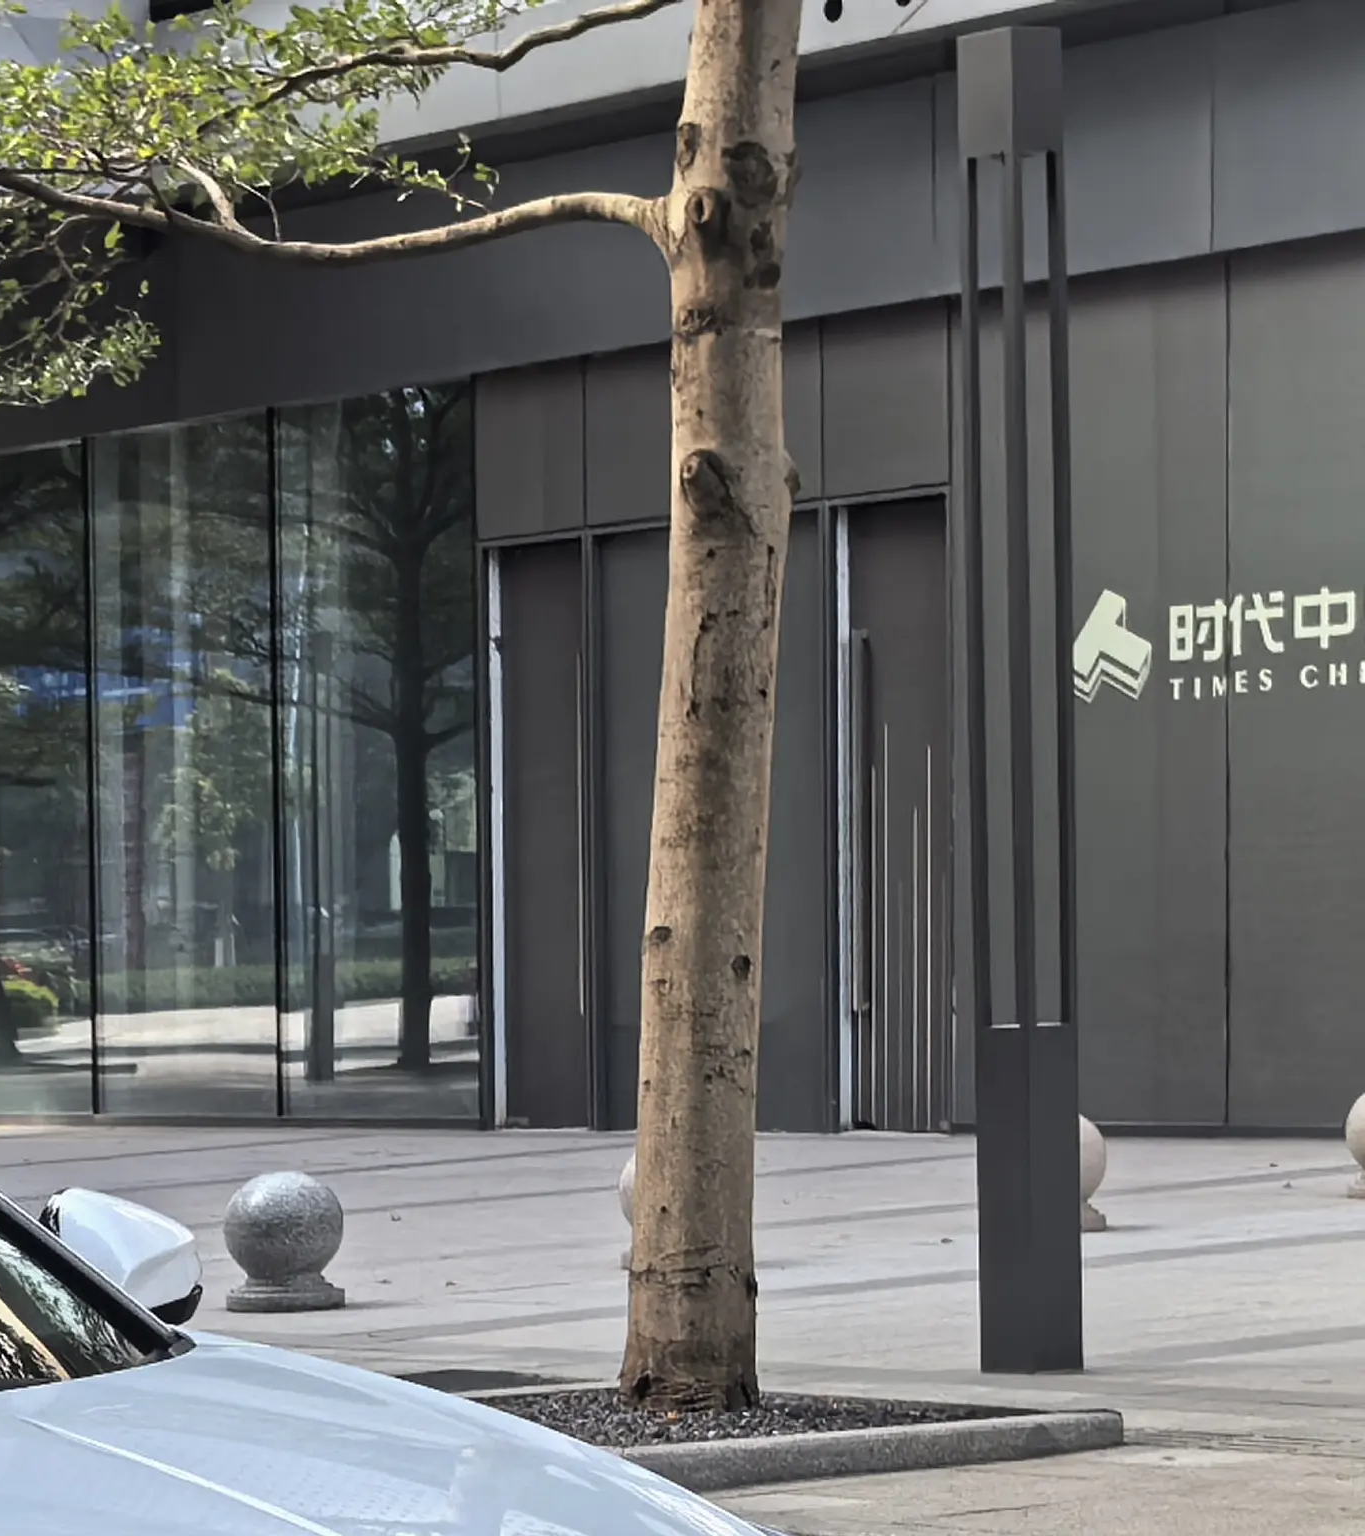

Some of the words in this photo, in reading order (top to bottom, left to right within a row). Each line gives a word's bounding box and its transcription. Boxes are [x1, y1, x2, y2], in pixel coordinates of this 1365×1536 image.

[1169, 585, 1357, 662] 时代中
[1169, 669, 1273, 701] TIMES
